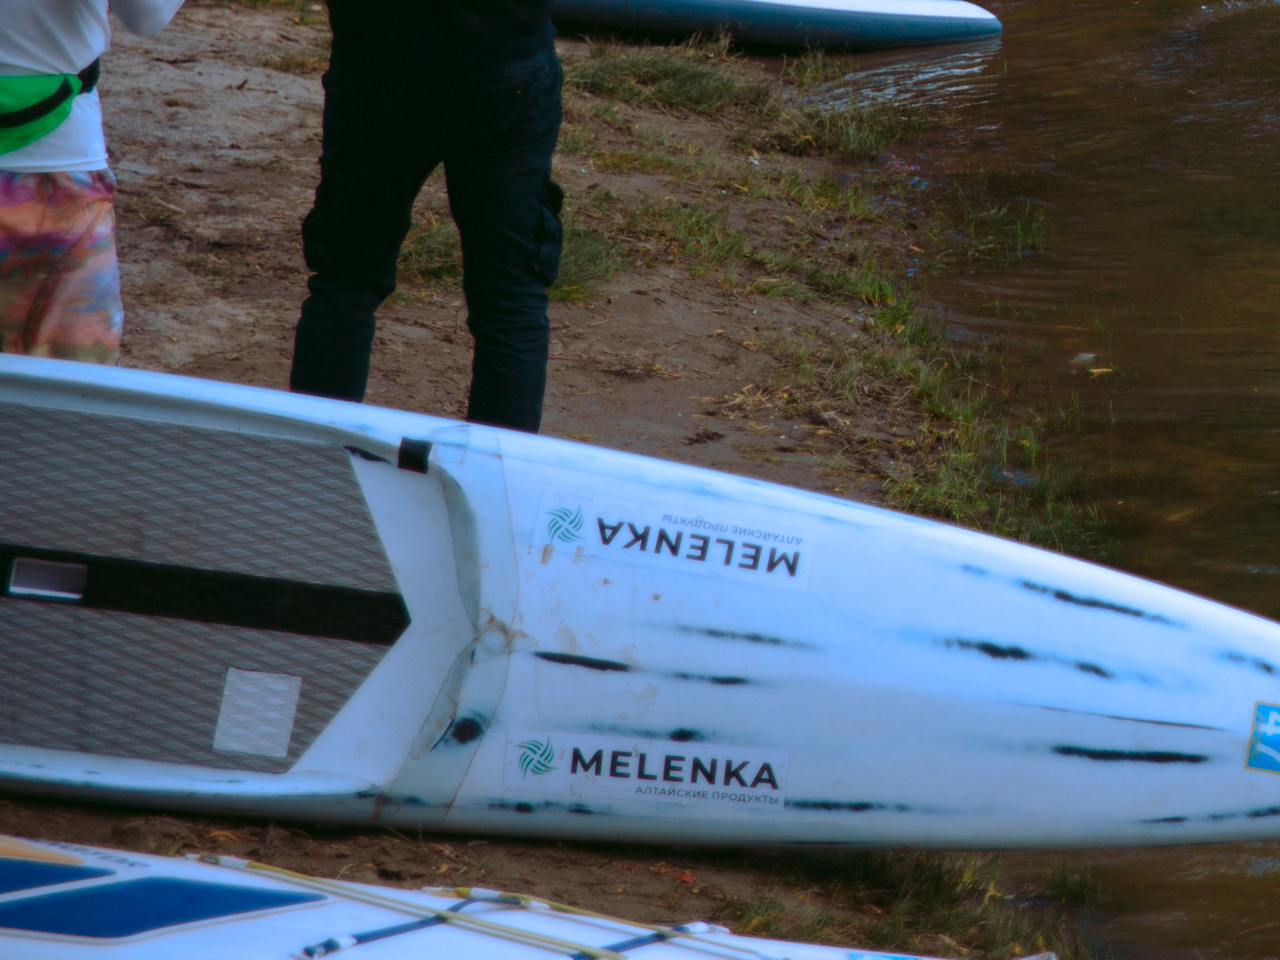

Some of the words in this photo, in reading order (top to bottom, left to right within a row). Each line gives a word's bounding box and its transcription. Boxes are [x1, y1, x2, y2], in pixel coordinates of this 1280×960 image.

[662, 513, 728, 533] ПРОДУКТЫ
[731, 526, 803, 545] АЛТАЙСКИЕ
[596, 517, 800, 577] MELENKA
[570, 747, 780, 790] MELENKA
[635, 785, 708, 800] АЛТАЙСКИЕ
[712, 791, 779, 805] ПРОДУКТЫ
